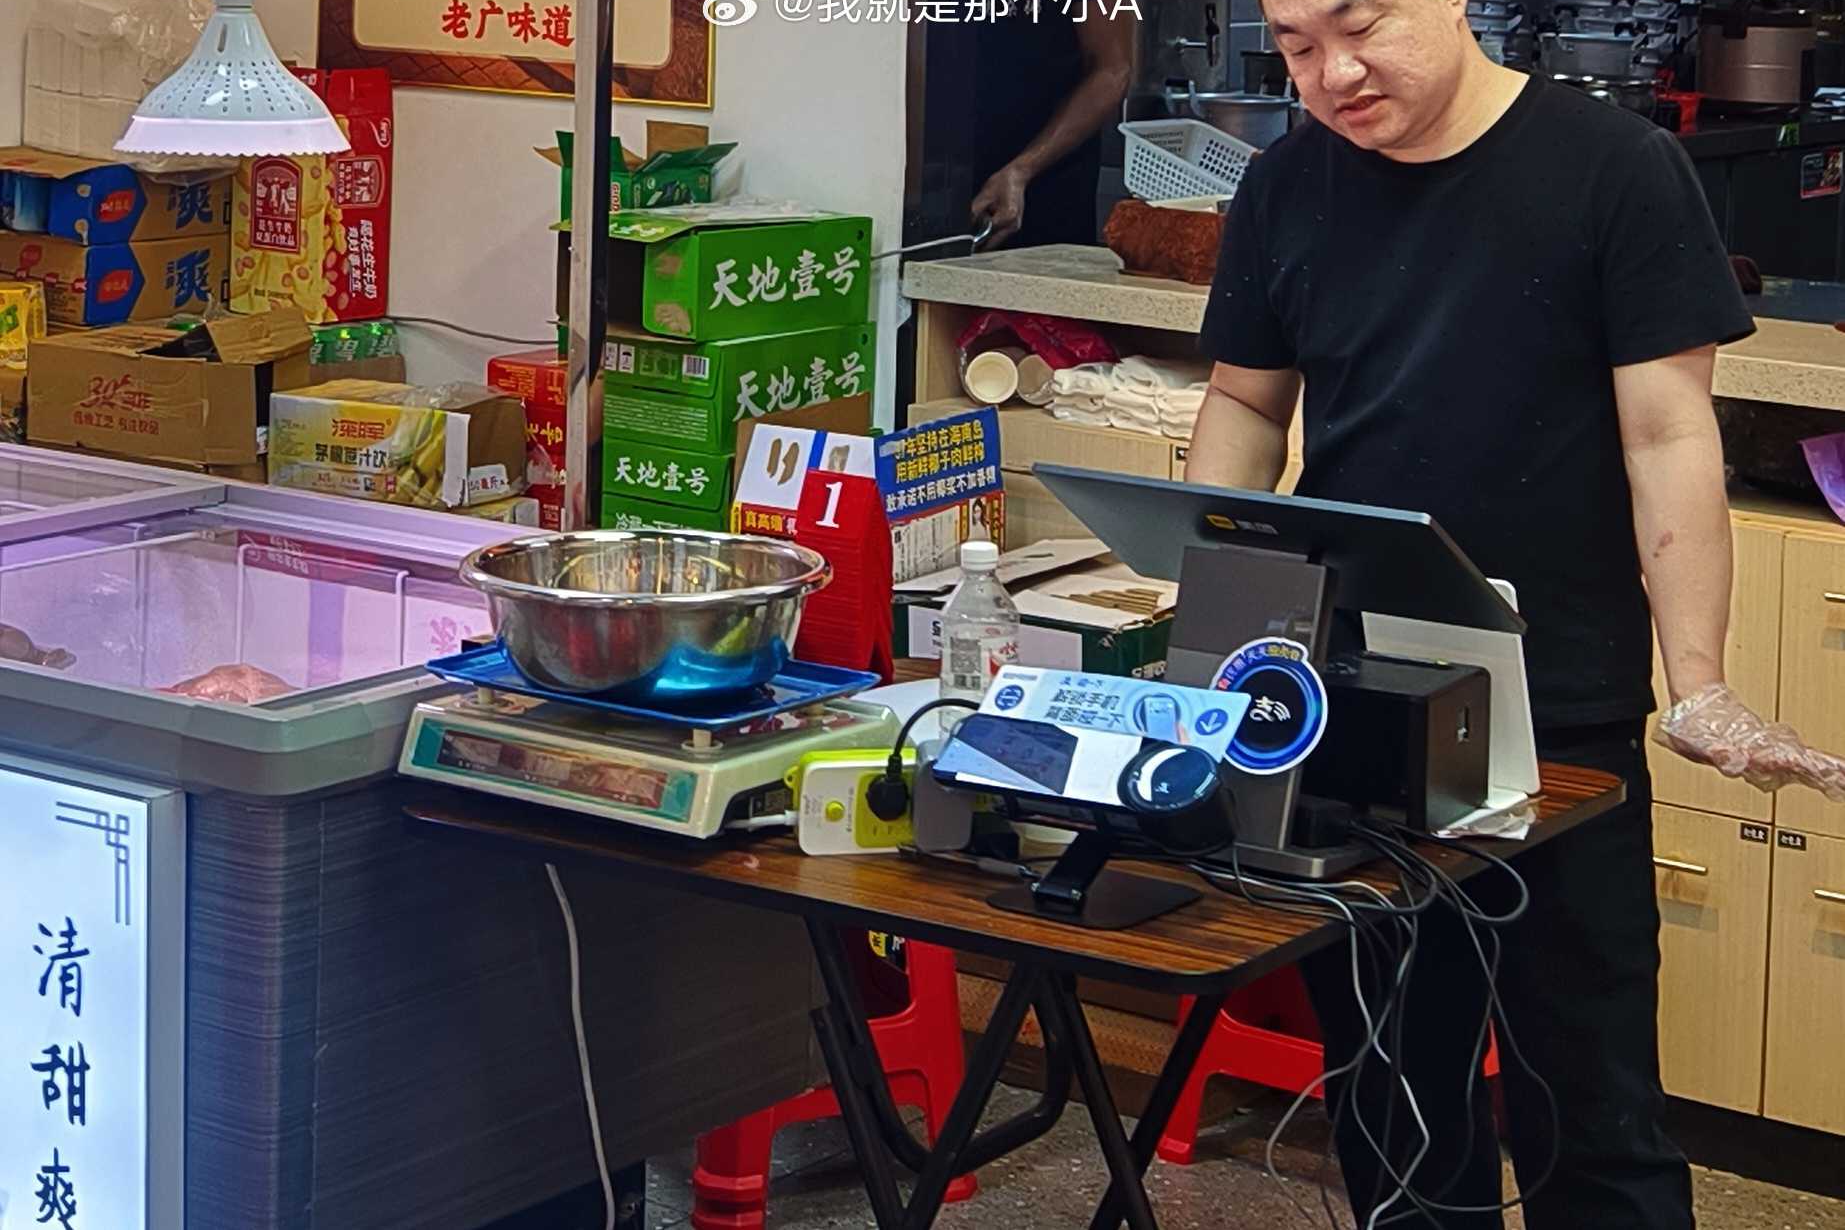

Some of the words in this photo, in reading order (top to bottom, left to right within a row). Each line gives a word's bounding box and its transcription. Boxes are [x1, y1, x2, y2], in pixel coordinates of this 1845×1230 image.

[708, 245, 861, 312] 天地壹号
[733, 350, 868, 424] 天地壹号
[614, 456, 711, 496] 天地壹号
[820, 480, 841, 529] 1
[30, 917, 92, 1230] 清甜爽
